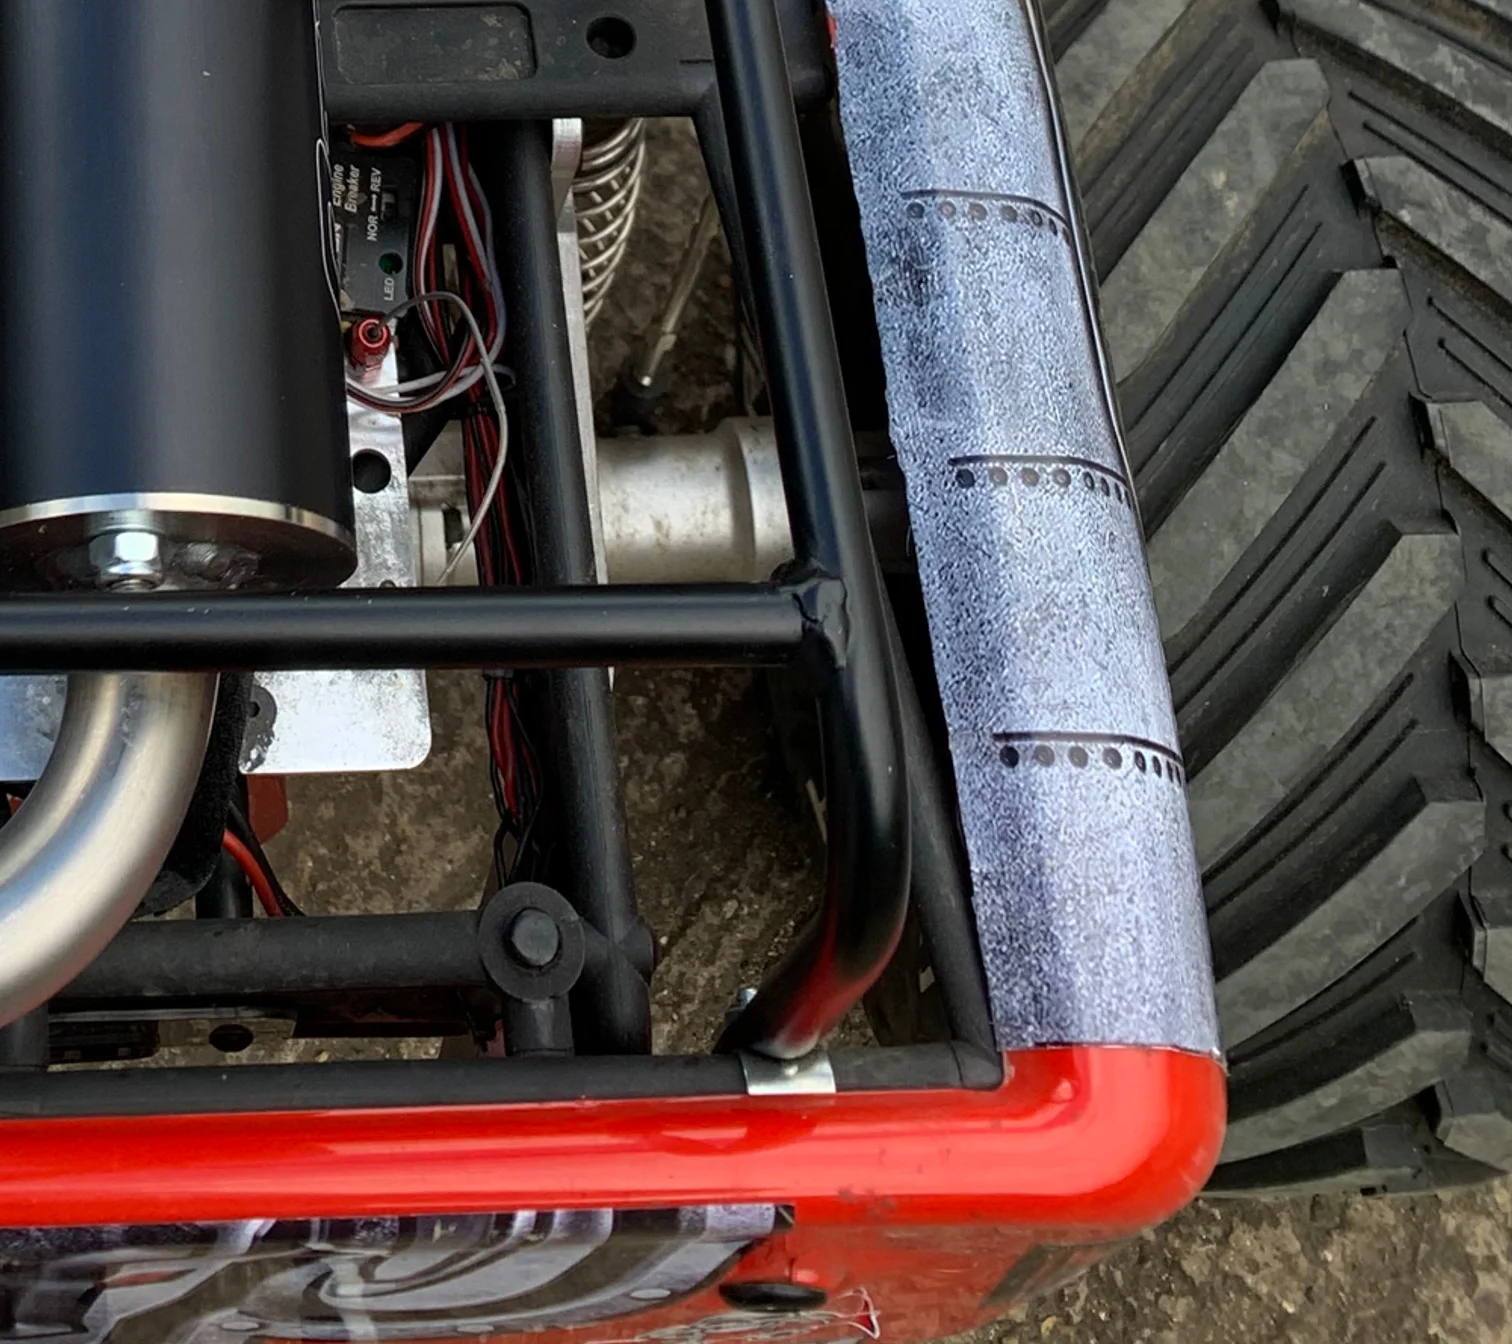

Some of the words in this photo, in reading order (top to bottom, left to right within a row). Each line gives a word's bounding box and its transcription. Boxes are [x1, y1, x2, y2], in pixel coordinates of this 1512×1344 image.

[332, 163, 346, 207] Engine
[344, 164, 360, 213] Breaker
[370, 167, 382, 192] REV
[366, 215, 379, 242] NOR
[384, 277, 395, 301] LED
